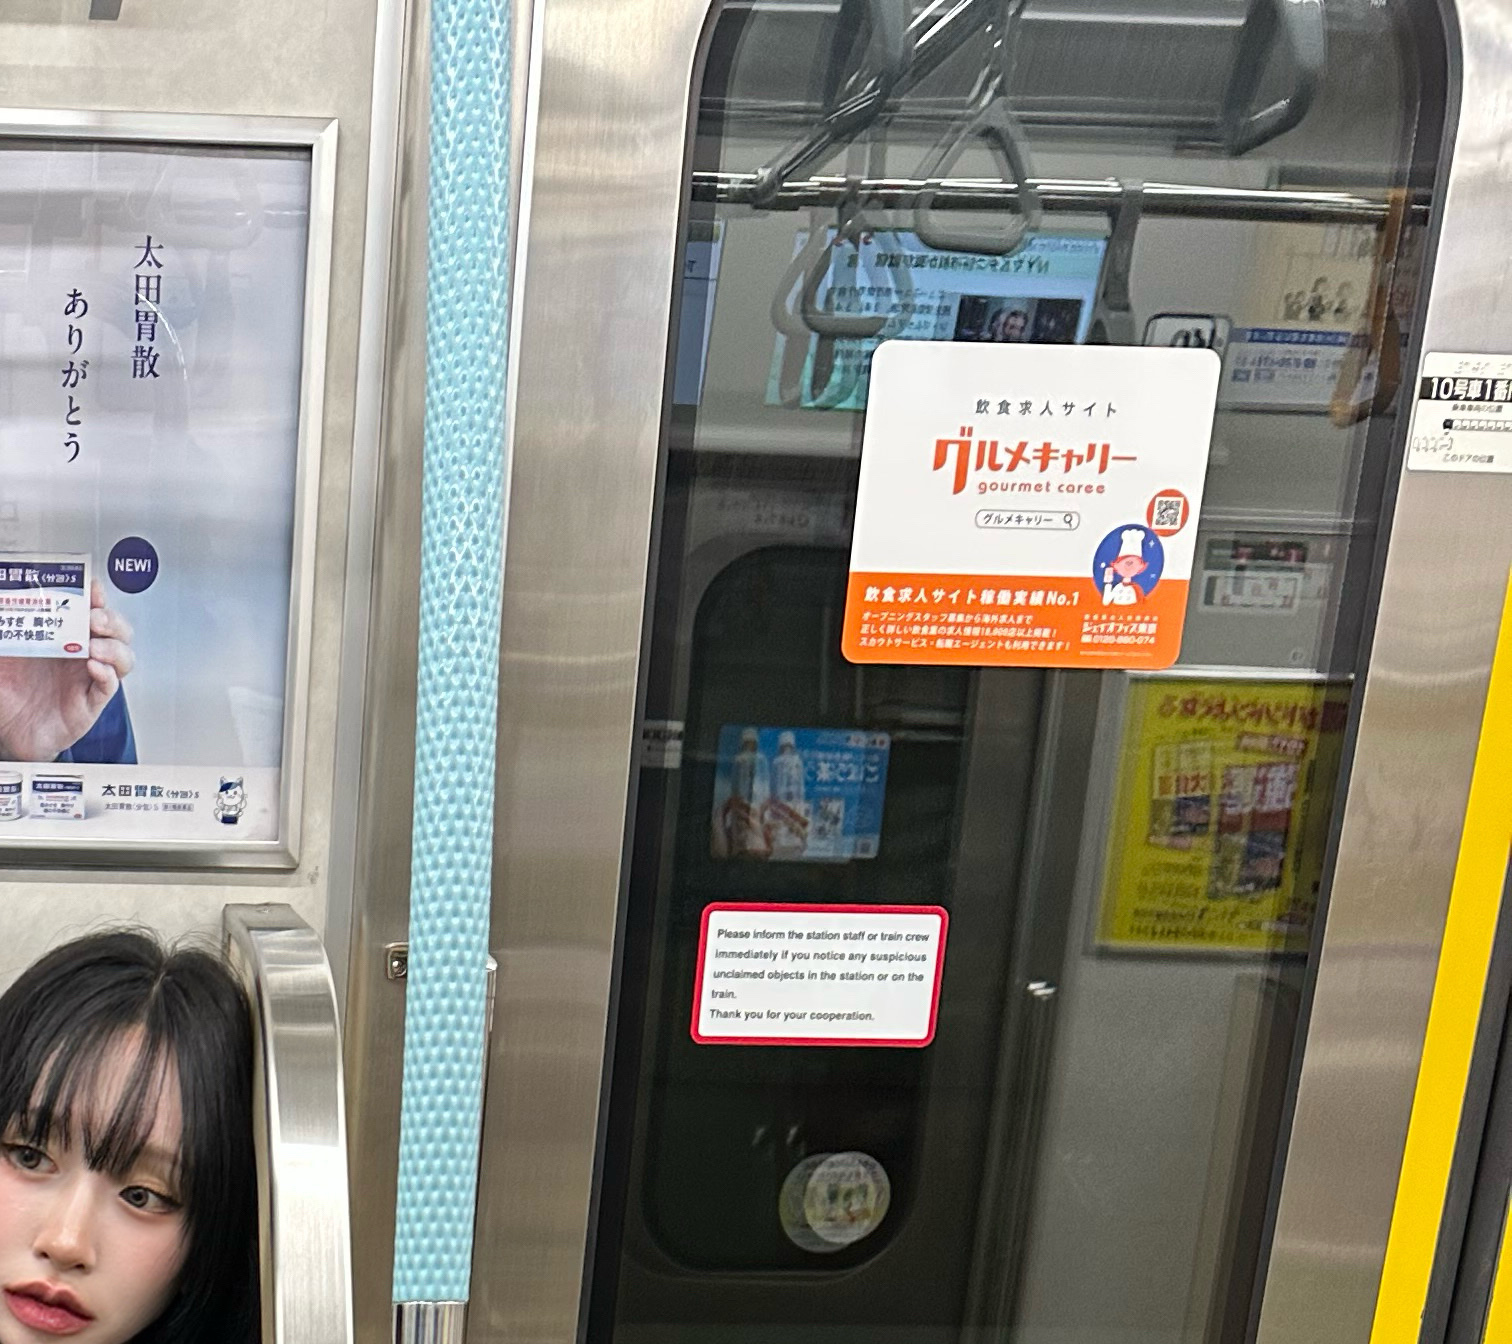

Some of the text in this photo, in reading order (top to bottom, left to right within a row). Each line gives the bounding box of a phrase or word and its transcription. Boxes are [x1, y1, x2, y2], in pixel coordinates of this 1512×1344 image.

[131, 235, 164, 379] 太田胃散
[61, 288, 90, 463] ありがとう
[975, 398, 1118, 417] 飲食求人サイト
[932, 426, 1137, 495] グルメキャリー
[978, 481, 1106, 495] gourmet caree
[983, 513, 1054, 525] グルメキャリー
[114, 558, 153, 573] NEW!
[863, 585, 1080, 606] 飲食求人サイト稼働実績No.1
[33, 616, 64, 628] 胸やけ
[717, 928, 930, 943] Please inform the station staff or train crew
[715, 949, 927, 964] immediately if you notice any suspicious
[713, 969, 924, 982] unclaimed objects in the station or on the
[711, 988, 738, 1000] train.
[709, 1008, 876, 1023] Thank you for your cooperation.
